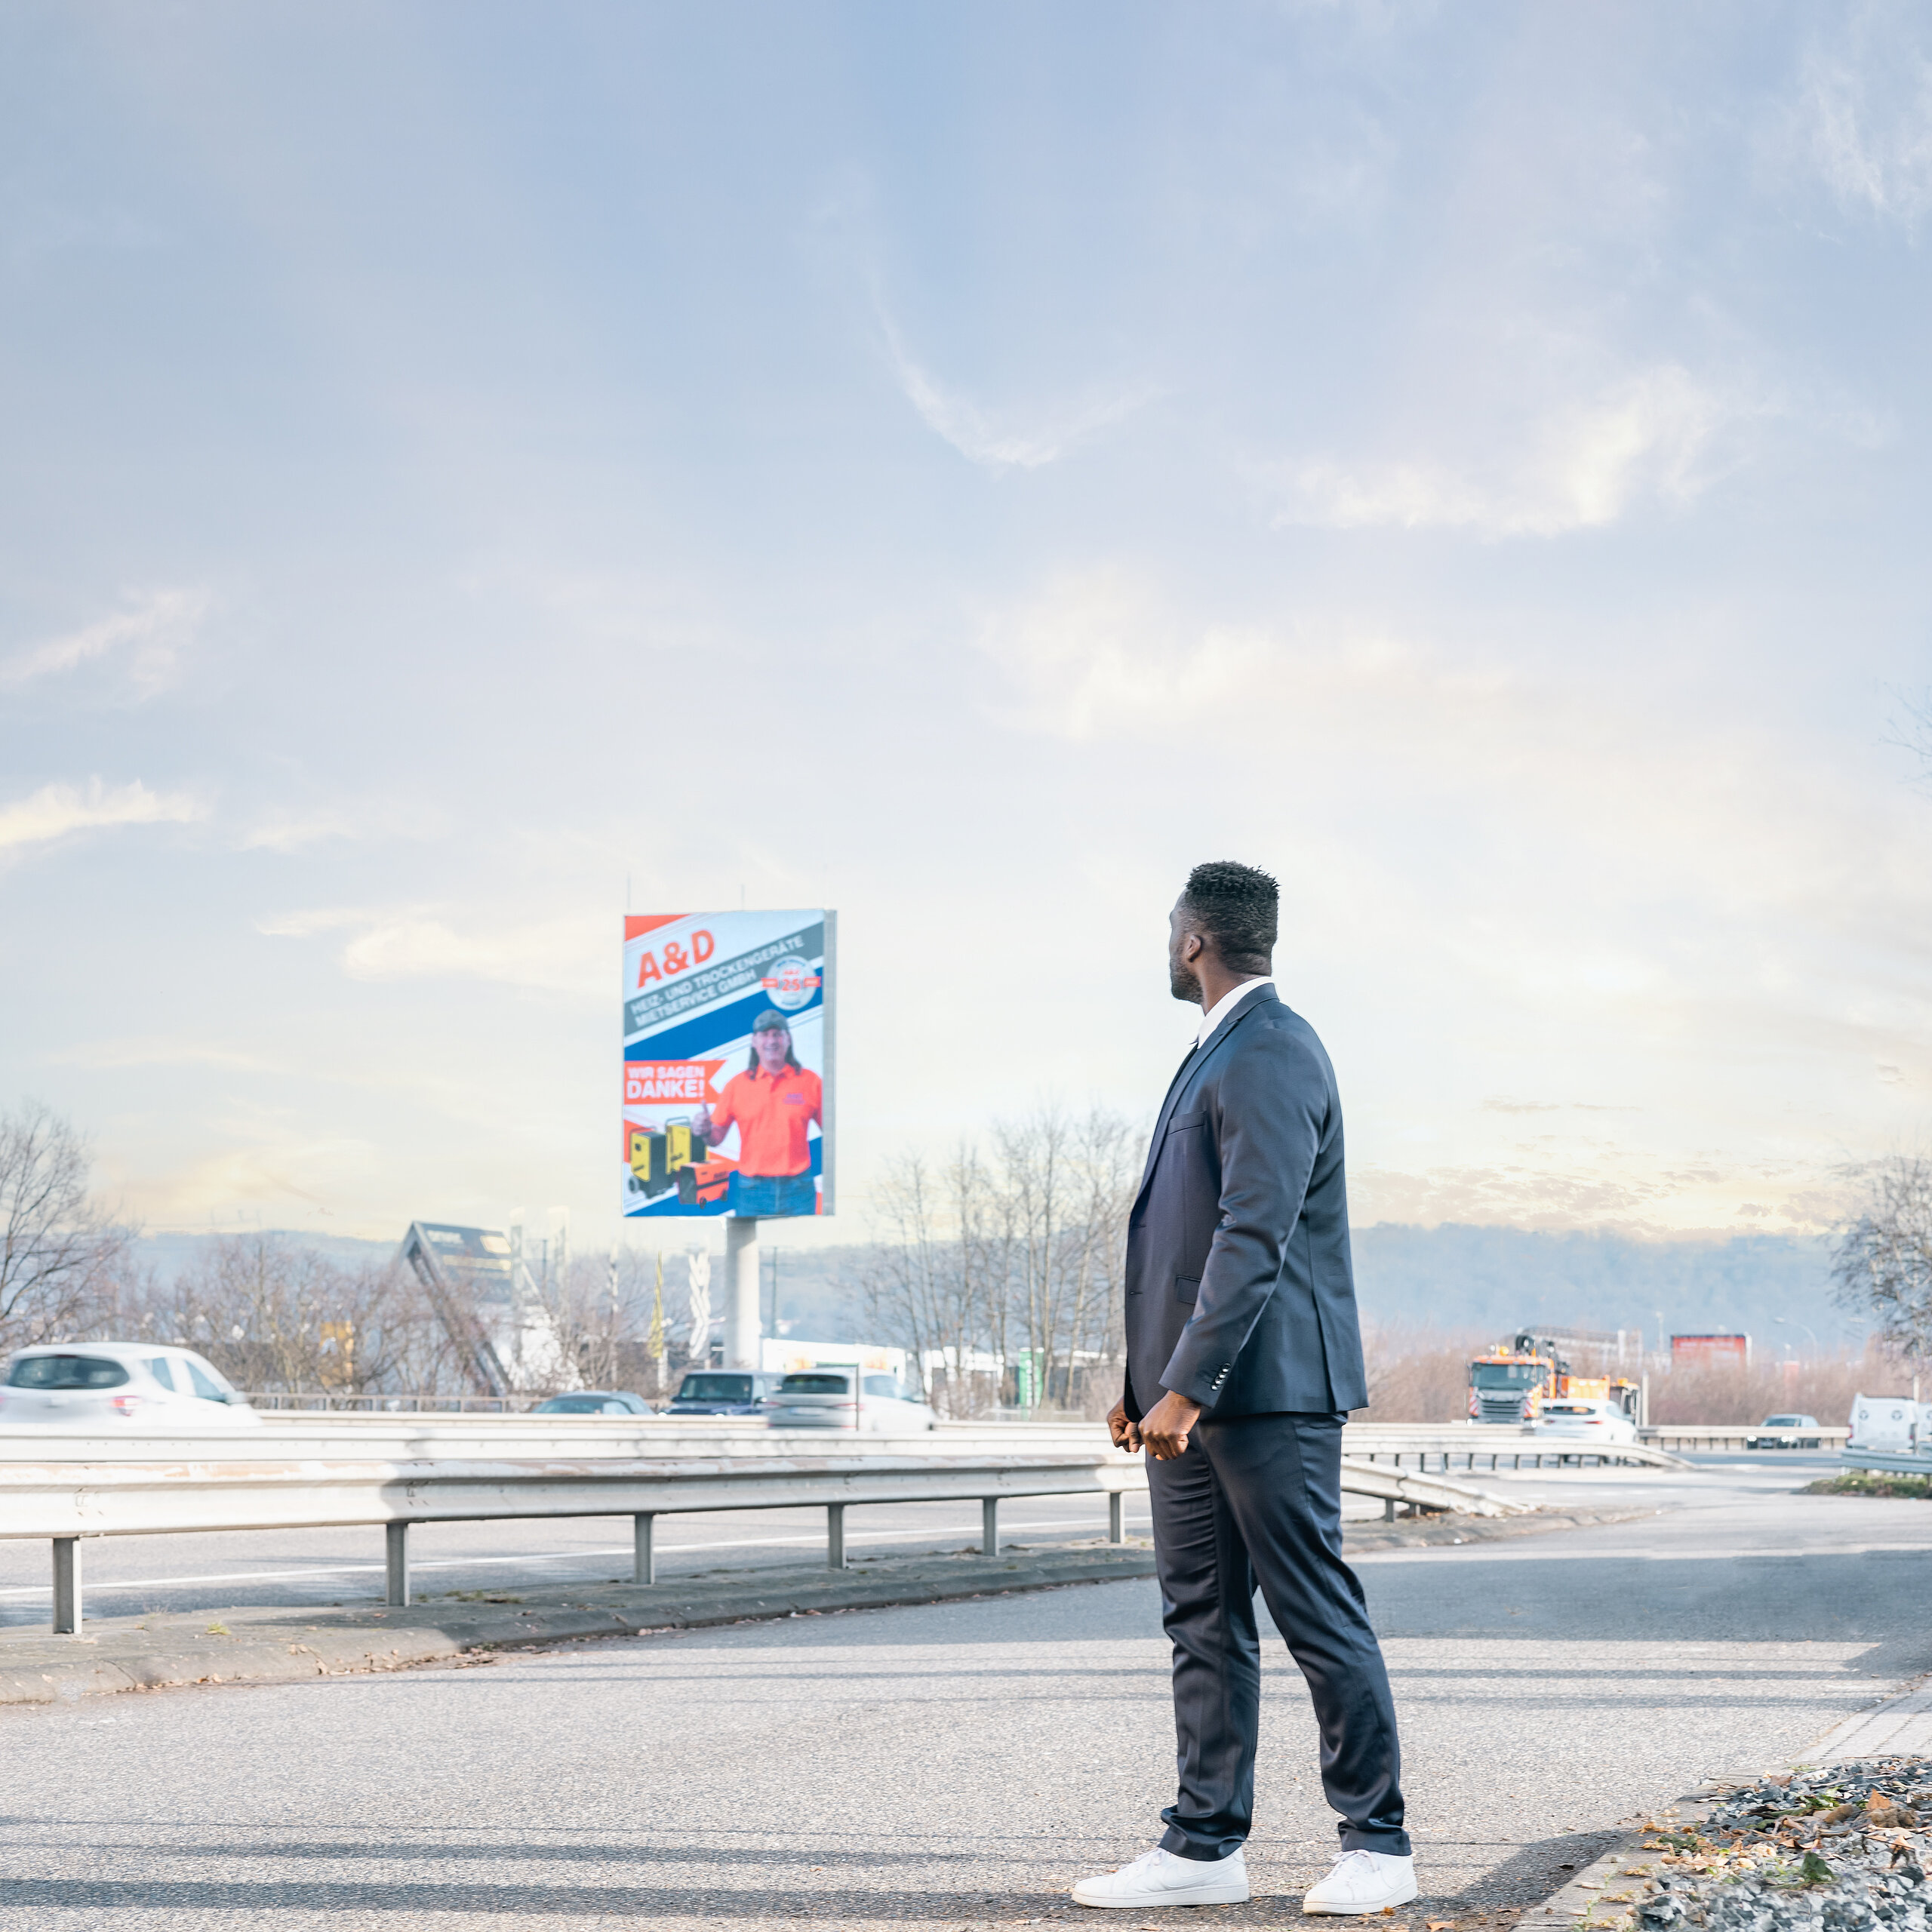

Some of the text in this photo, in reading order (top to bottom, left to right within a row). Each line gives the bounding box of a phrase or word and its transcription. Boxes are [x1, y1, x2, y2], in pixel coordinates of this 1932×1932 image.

[638, 930, 715, 989] A&D
[665, 983, 693, 1001] UND
[694, 935, 804, 986] TROCKENGERÄTE
[782, 978, 801, 991] 25
[635, 987, 717, 1028] MIETSERVICE
[627, 1066, 705, 1080] WIR SAGEN
[626, 1079, 706, 1099] DANKE!
